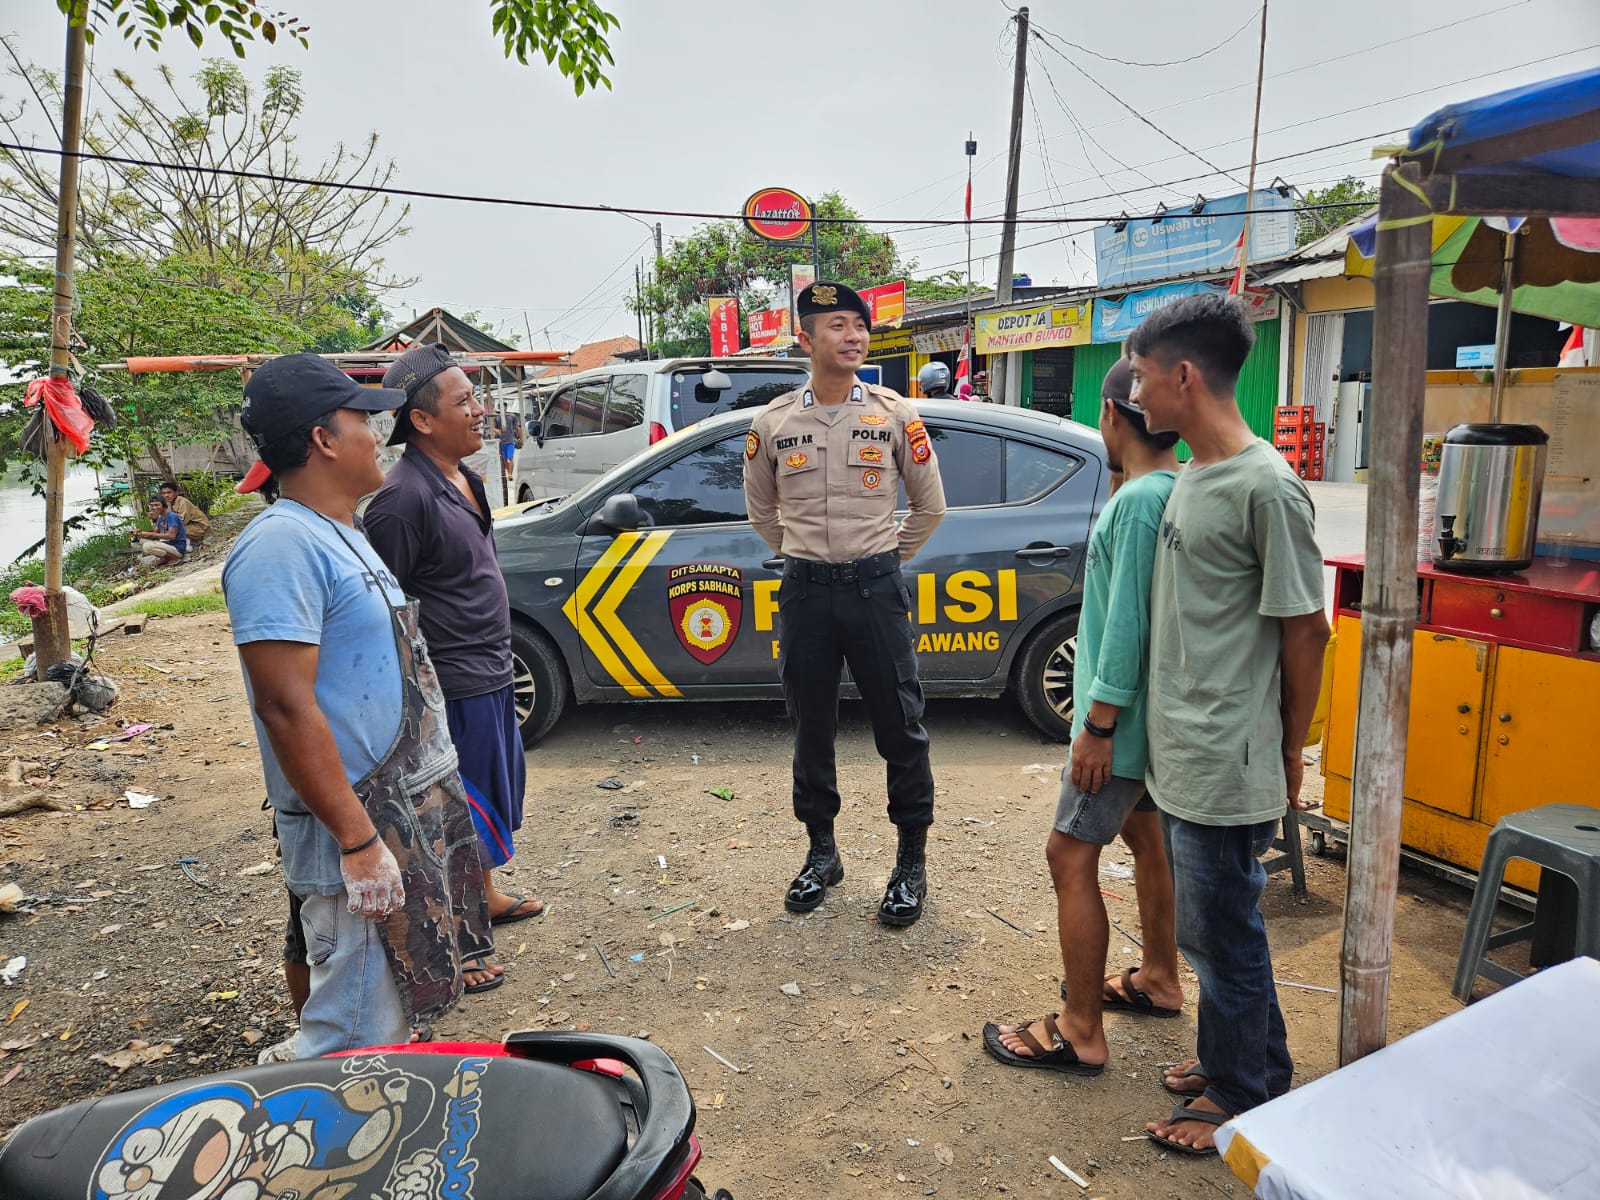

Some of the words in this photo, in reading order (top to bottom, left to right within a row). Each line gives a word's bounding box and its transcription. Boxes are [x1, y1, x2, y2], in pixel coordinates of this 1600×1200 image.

[1151, 216, 1191, 236] Uswah
[1193, 212, 1217, 227] Cell
[750, 321, 763, 331] HOT
[997, 314, 1032, 330] DEPOT
[1033, 312, 1046, 326] JA
[1035, 327, 1073, 342] BUNGO
[776, 436, 798, 450] RIZKY
[801, 434, 813, 445] AR
[852, 430, 891, 442] POLRI
[669, 581, 697, 598] KORPS
[699, 580, 740, 597] SABHARA
[911, 631, 1000, 653] AWANG
